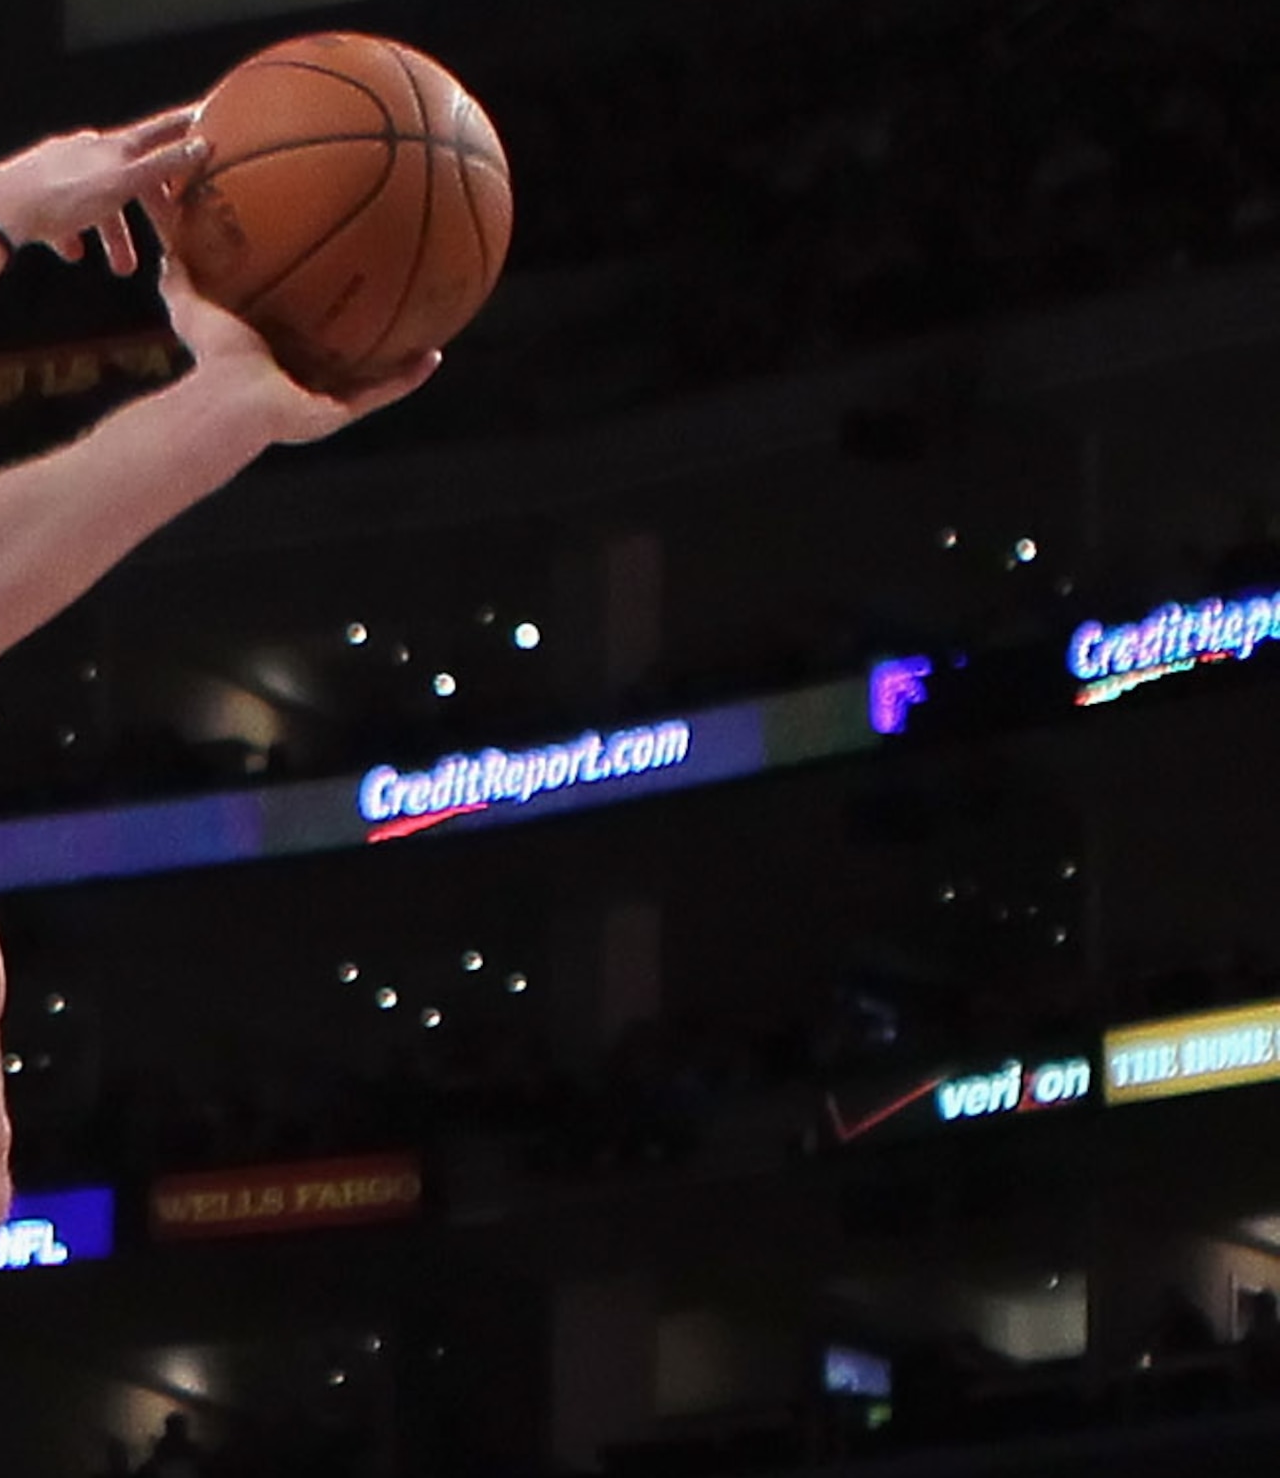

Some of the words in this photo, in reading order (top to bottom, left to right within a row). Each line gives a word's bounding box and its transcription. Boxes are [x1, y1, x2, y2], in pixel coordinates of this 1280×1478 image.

[358, 719, 692, 823] CreditReport.com
[155, 1184, 286, 1223] WELLS
[292, 1173, 423, 1215] FARGO
